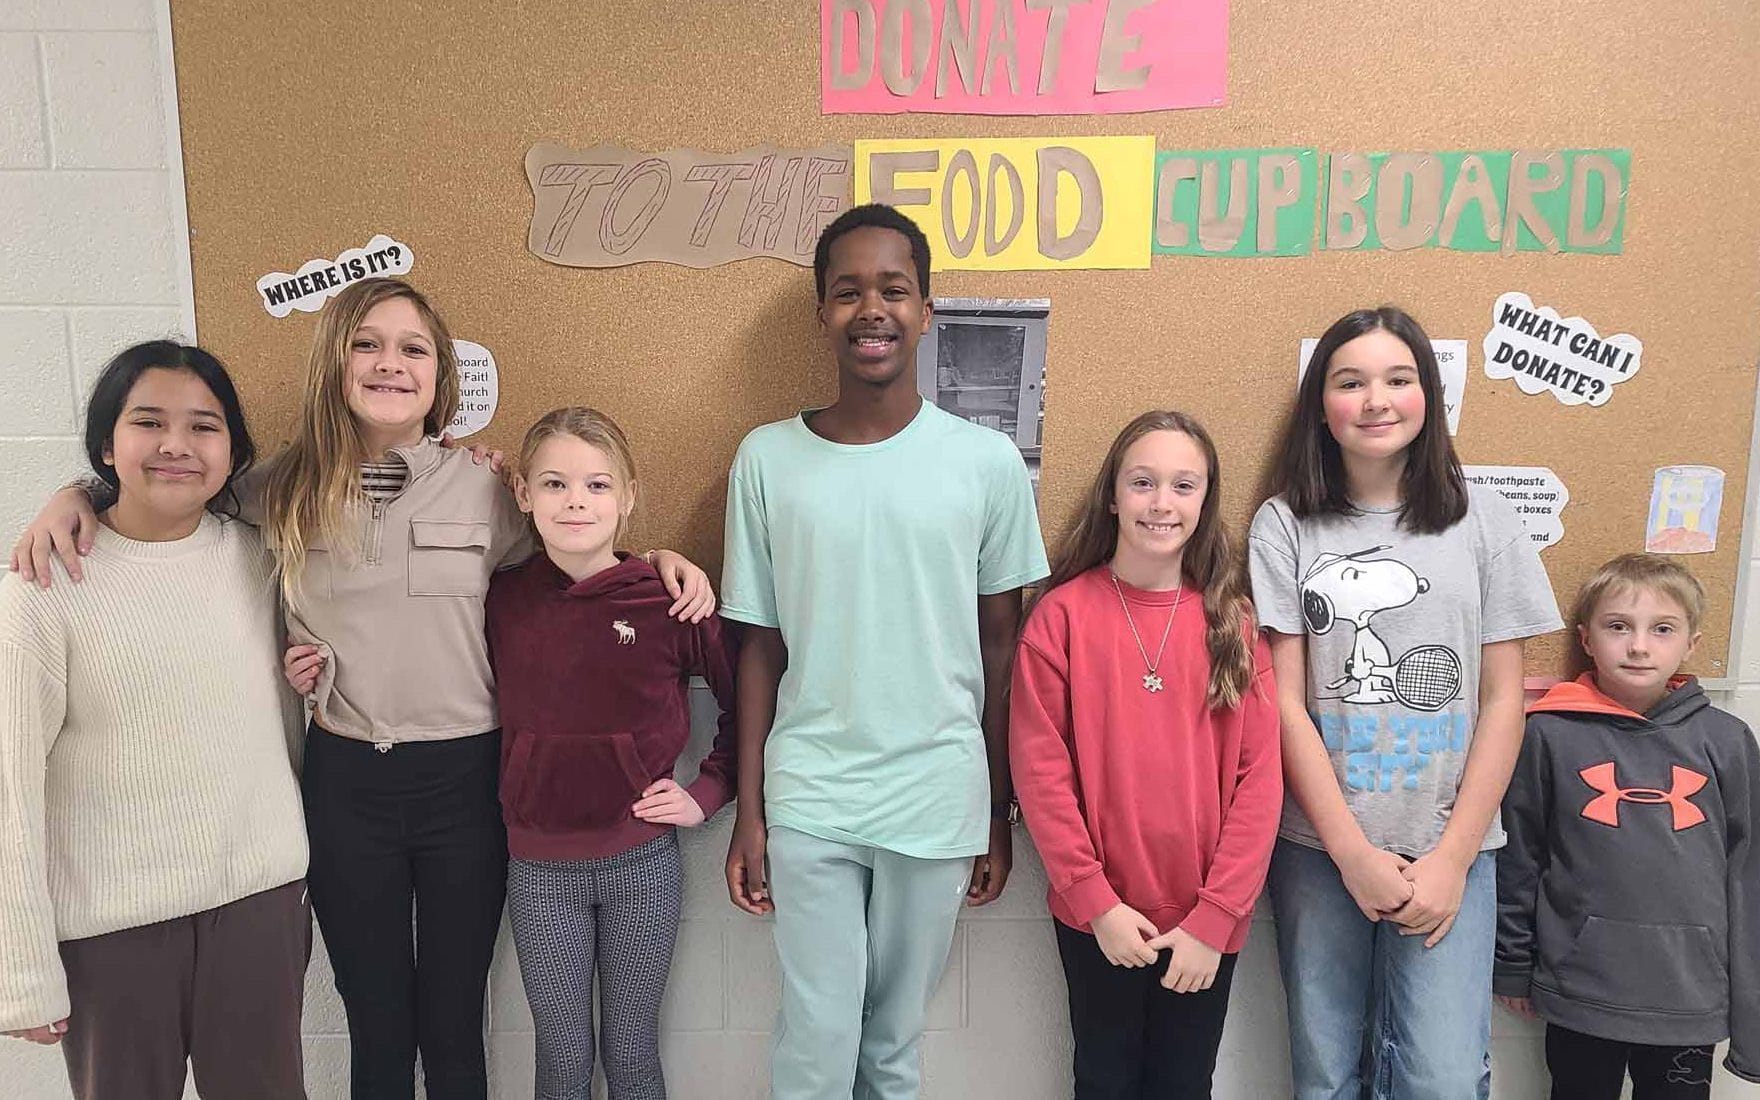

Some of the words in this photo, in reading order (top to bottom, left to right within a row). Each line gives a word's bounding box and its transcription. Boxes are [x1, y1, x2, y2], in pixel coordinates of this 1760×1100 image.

[829, 0, 1153, 98] DONATE
[539, 158, 671, 257] TO
[683, 153, 848, 254] THE
[868, 146, 1104, 262] FOOD
[264, 268, 342, 306] WHERE
[341, 258, 366, 282] IS
[367, 245, 402, 274] IT?
[1499, 303, 1570, 347] WHAT
[1569, 333, 1621, 369] CAN
[1619, 352, 1634, 374] I
[1492, 341, 1605, 401] DONATE?
[466, 401, 474, 411] it
[1523, 504, 1552, 514] boxes
